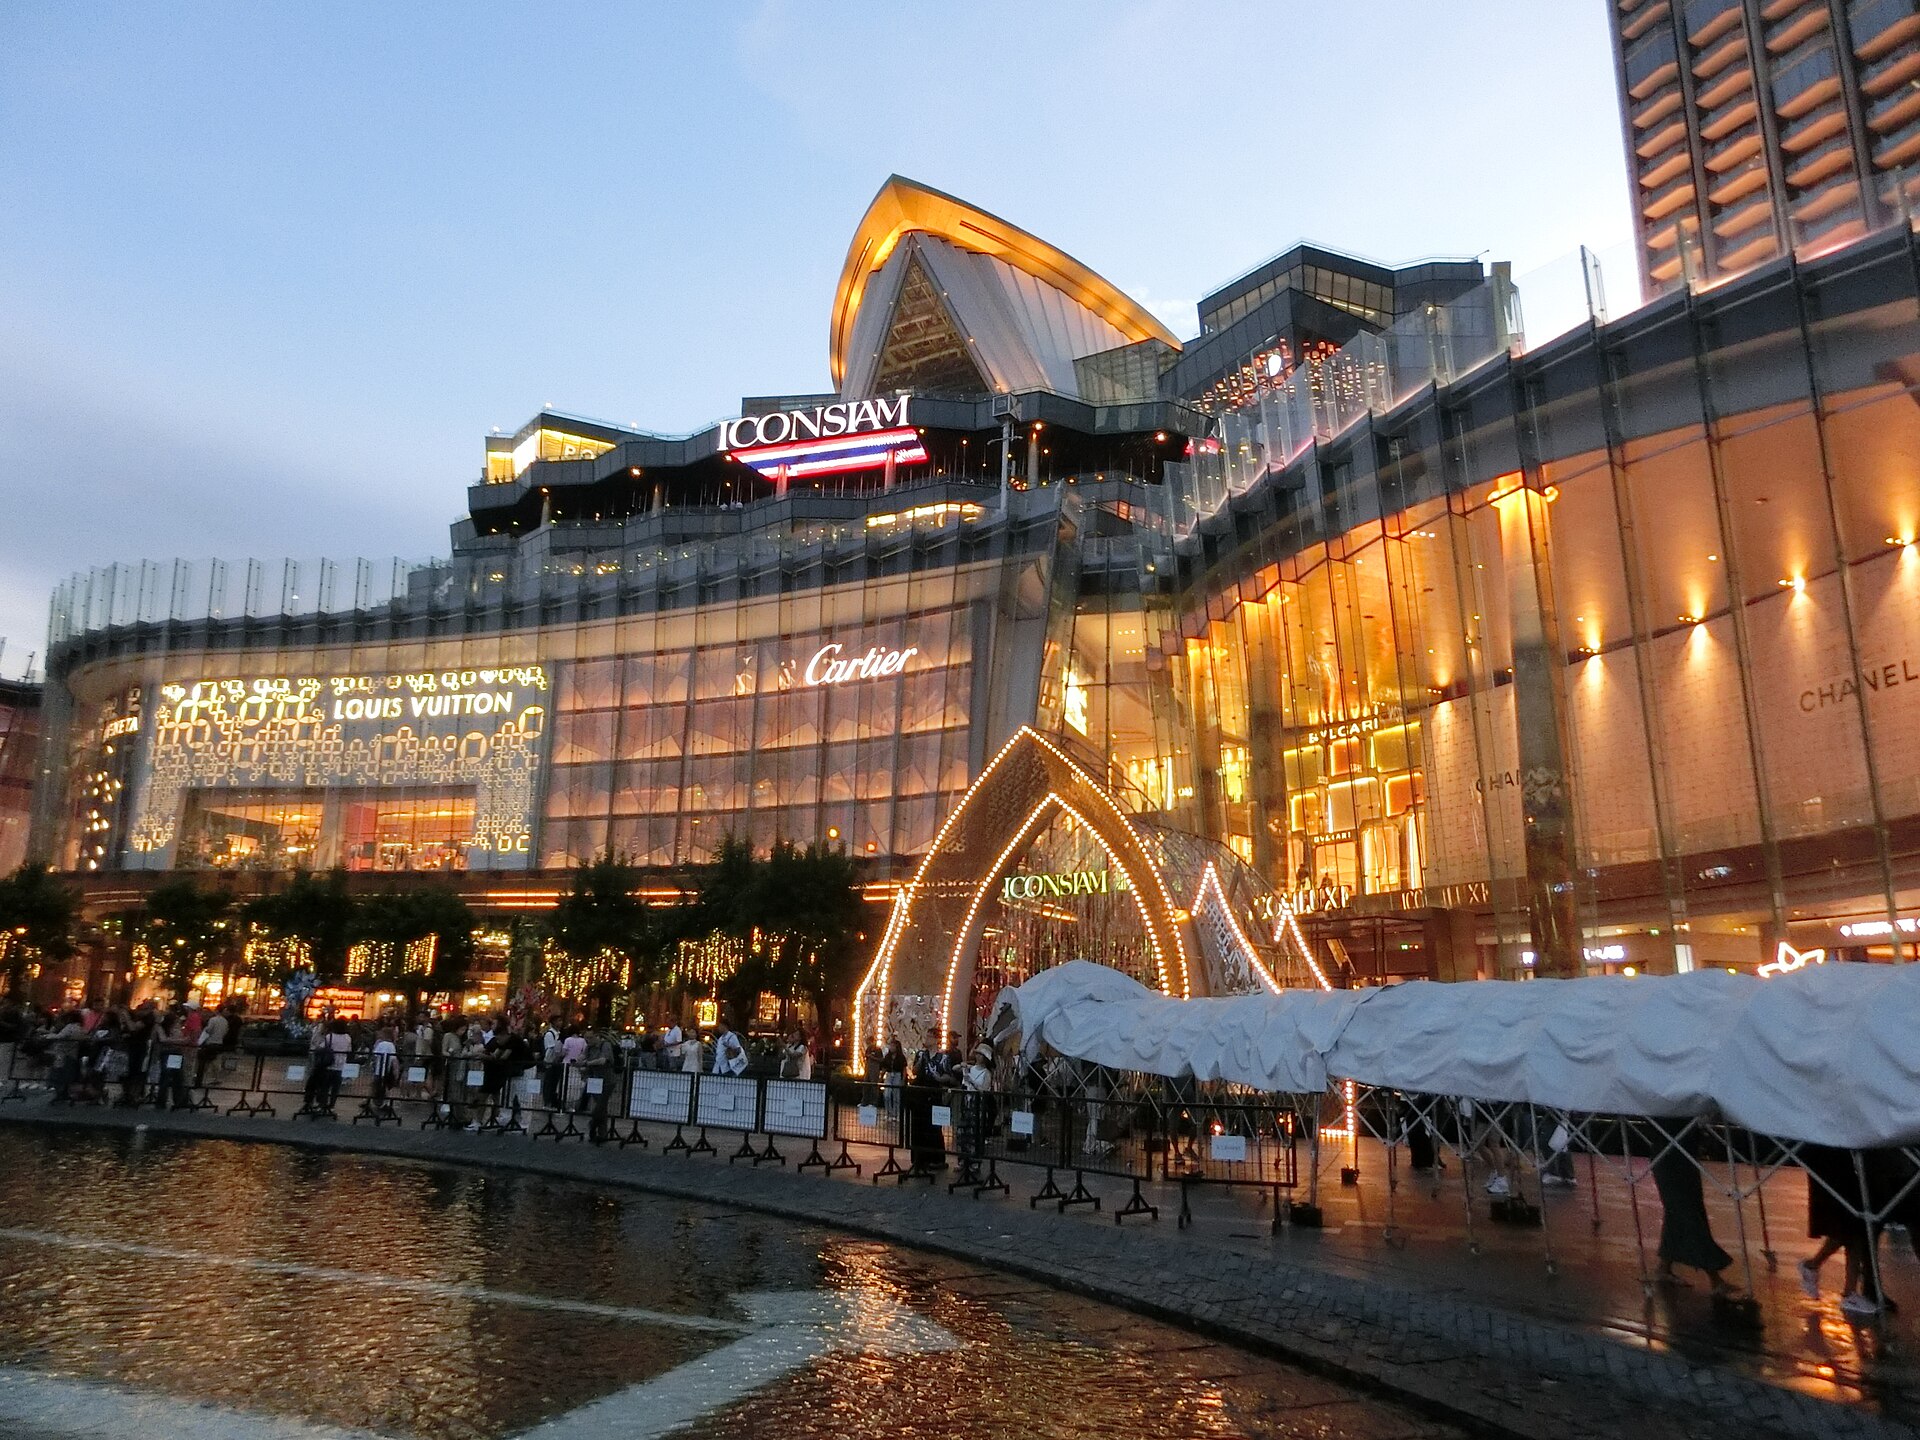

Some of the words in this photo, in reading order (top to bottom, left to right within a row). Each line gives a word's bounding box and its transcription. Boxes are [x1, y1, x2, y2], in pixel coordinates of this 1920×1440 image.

[717, 395, 912, 451] ICONSIAM
[805, 643, 918, 686] Cartier
[1800, 659, 1919, 712] CHANEL
[333, 697, 403, 720] LOUIS
[410, 691, 512, 717] VUITTON
[1003, 869, 1108, 899] ICONSIAM
